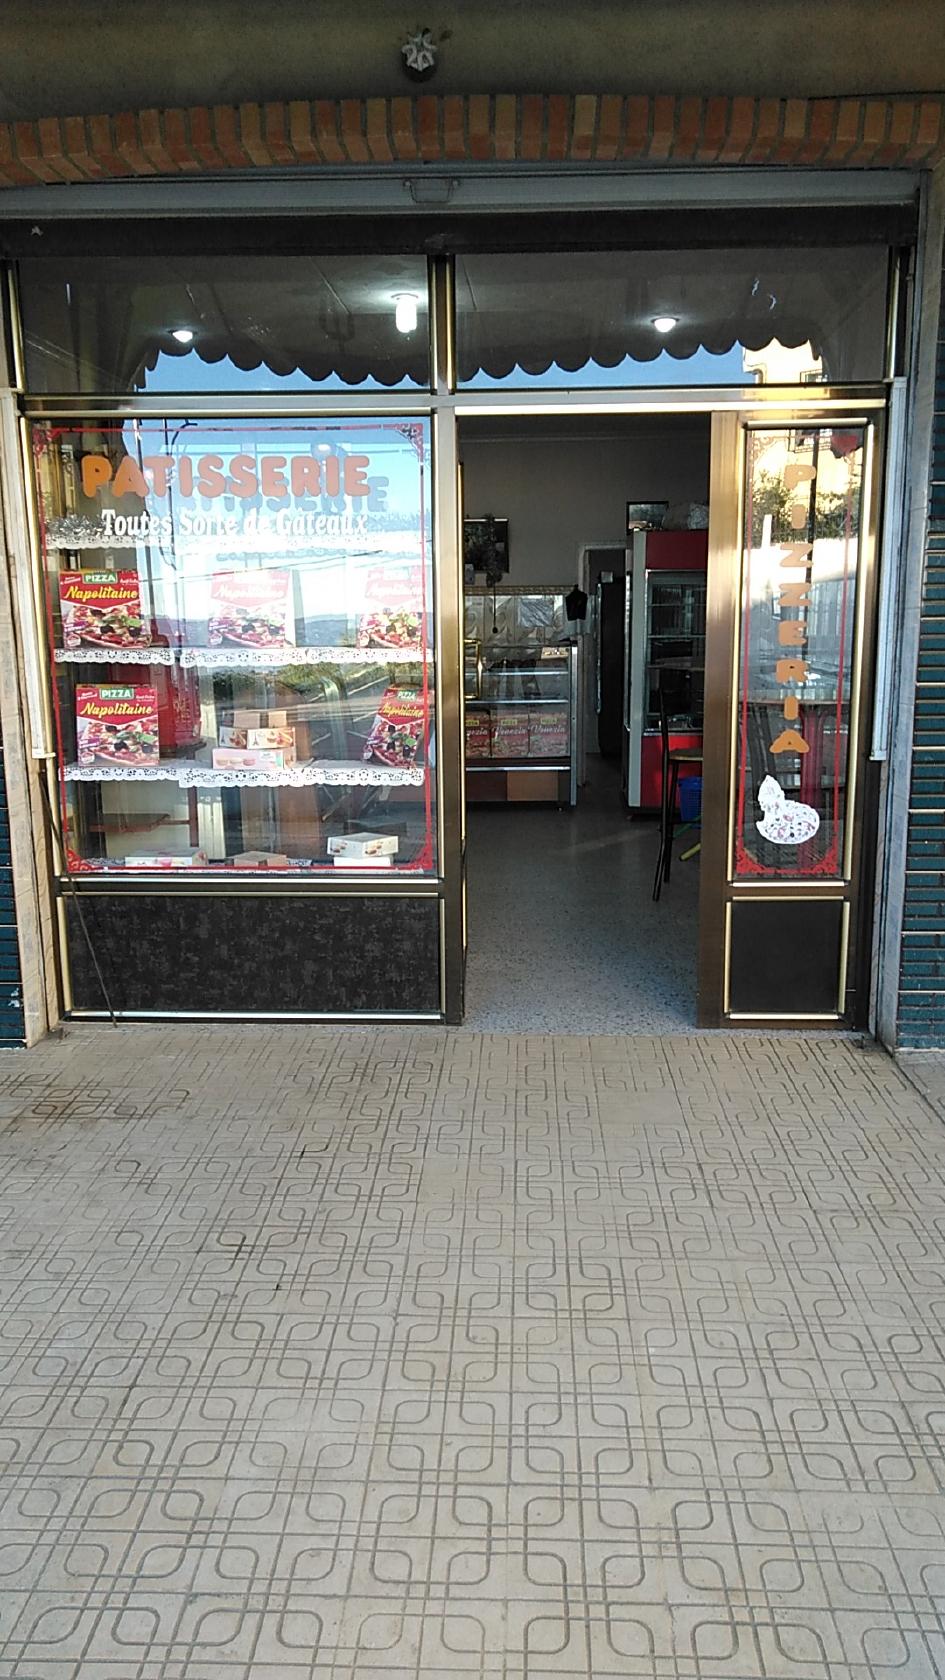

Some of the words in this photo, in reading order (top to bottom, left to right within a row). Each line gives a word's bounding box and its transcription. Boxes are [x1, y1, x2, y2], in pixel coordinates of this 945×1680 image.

[81, 454, 370, 498] PATISSERIE
[101, 508, 172, 536] Toutes
[242, 506, 272, 536] de
[85, 574, 116, 582] PIZZA
[64, 585, 138, 602] Napolitaine
[101, 689, 131, 698] PIZZA
[80, 702, 154, 718] Napolitaine
